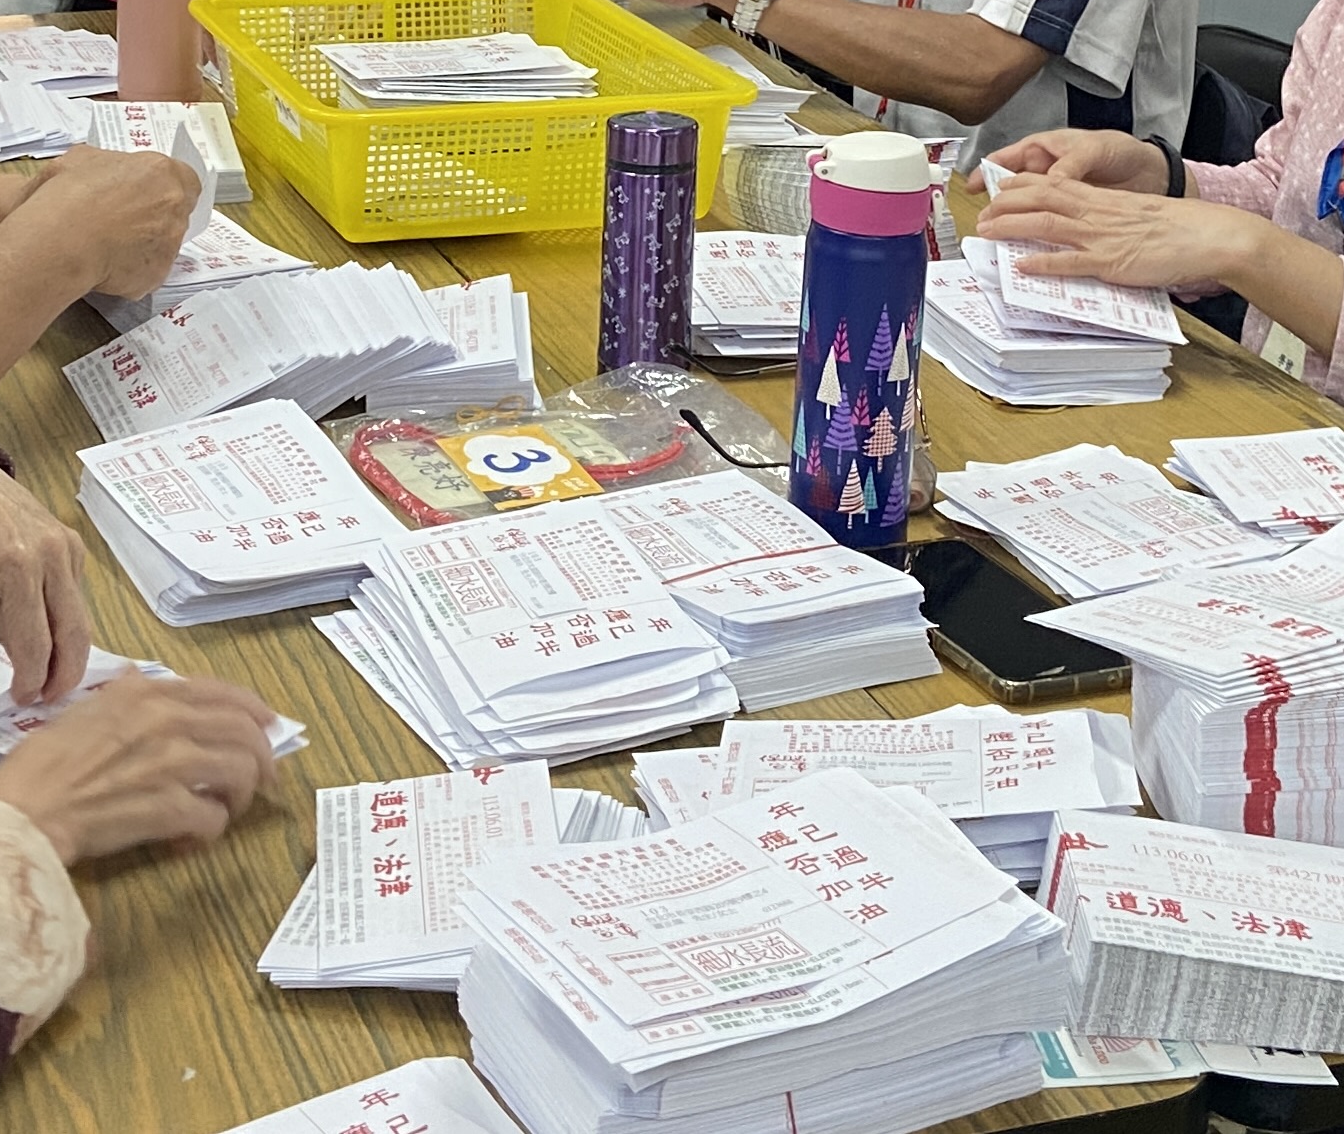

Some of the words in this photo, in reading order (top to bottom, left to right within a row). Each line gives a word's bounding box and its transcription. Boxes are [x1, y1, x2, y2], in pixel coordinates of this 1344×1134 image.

[482, 448, 553, 475] 3
[232, 515, 361, 552] 年已過半
[489, 607, 632, 651] 應否加油
[533, 615, 674, 658] 年已過半
[984, 729, 1020, 792] 應否加油
[1019, 717, 1056, 772] 年已過半
[369, 790, 414, 899] 道德、法律
[766, 799, 896, 893] 年已過半
[1131, 843, 1215, 866] 113.06.01
[757, 828, 889, 926] 應否加油
[1105, 890, 1314, 942] 道德、法律
[690, 934, 800, 975] 細水長流
